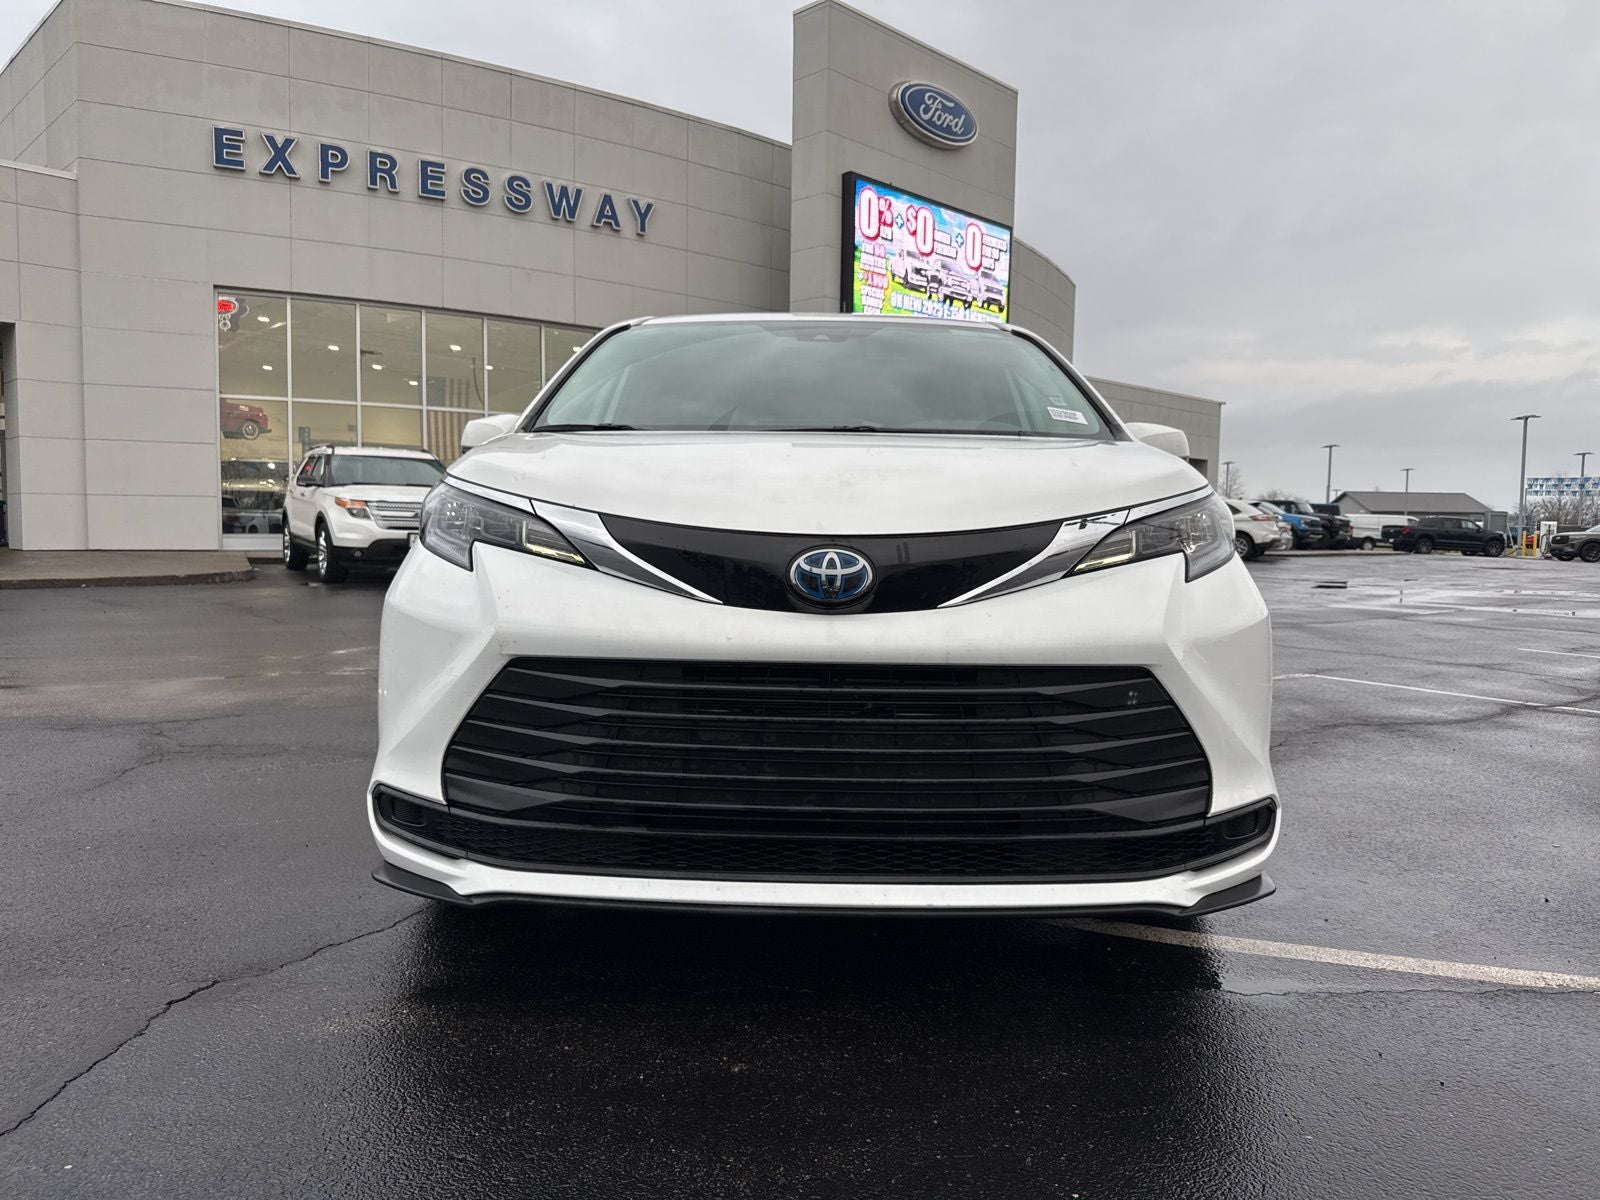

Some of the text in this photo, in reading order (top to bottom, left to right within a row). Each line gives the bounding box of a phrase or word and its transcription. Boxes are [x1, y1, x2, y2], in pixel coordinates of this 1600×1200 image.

[919, 92, 965, 135] Ford
[212, 124, 655, 236] EXPRESSWAY
[859, 188, 893, 240] 0%
[906, 205, 934, 257] $0
[965, 223, 983, 271] 0
